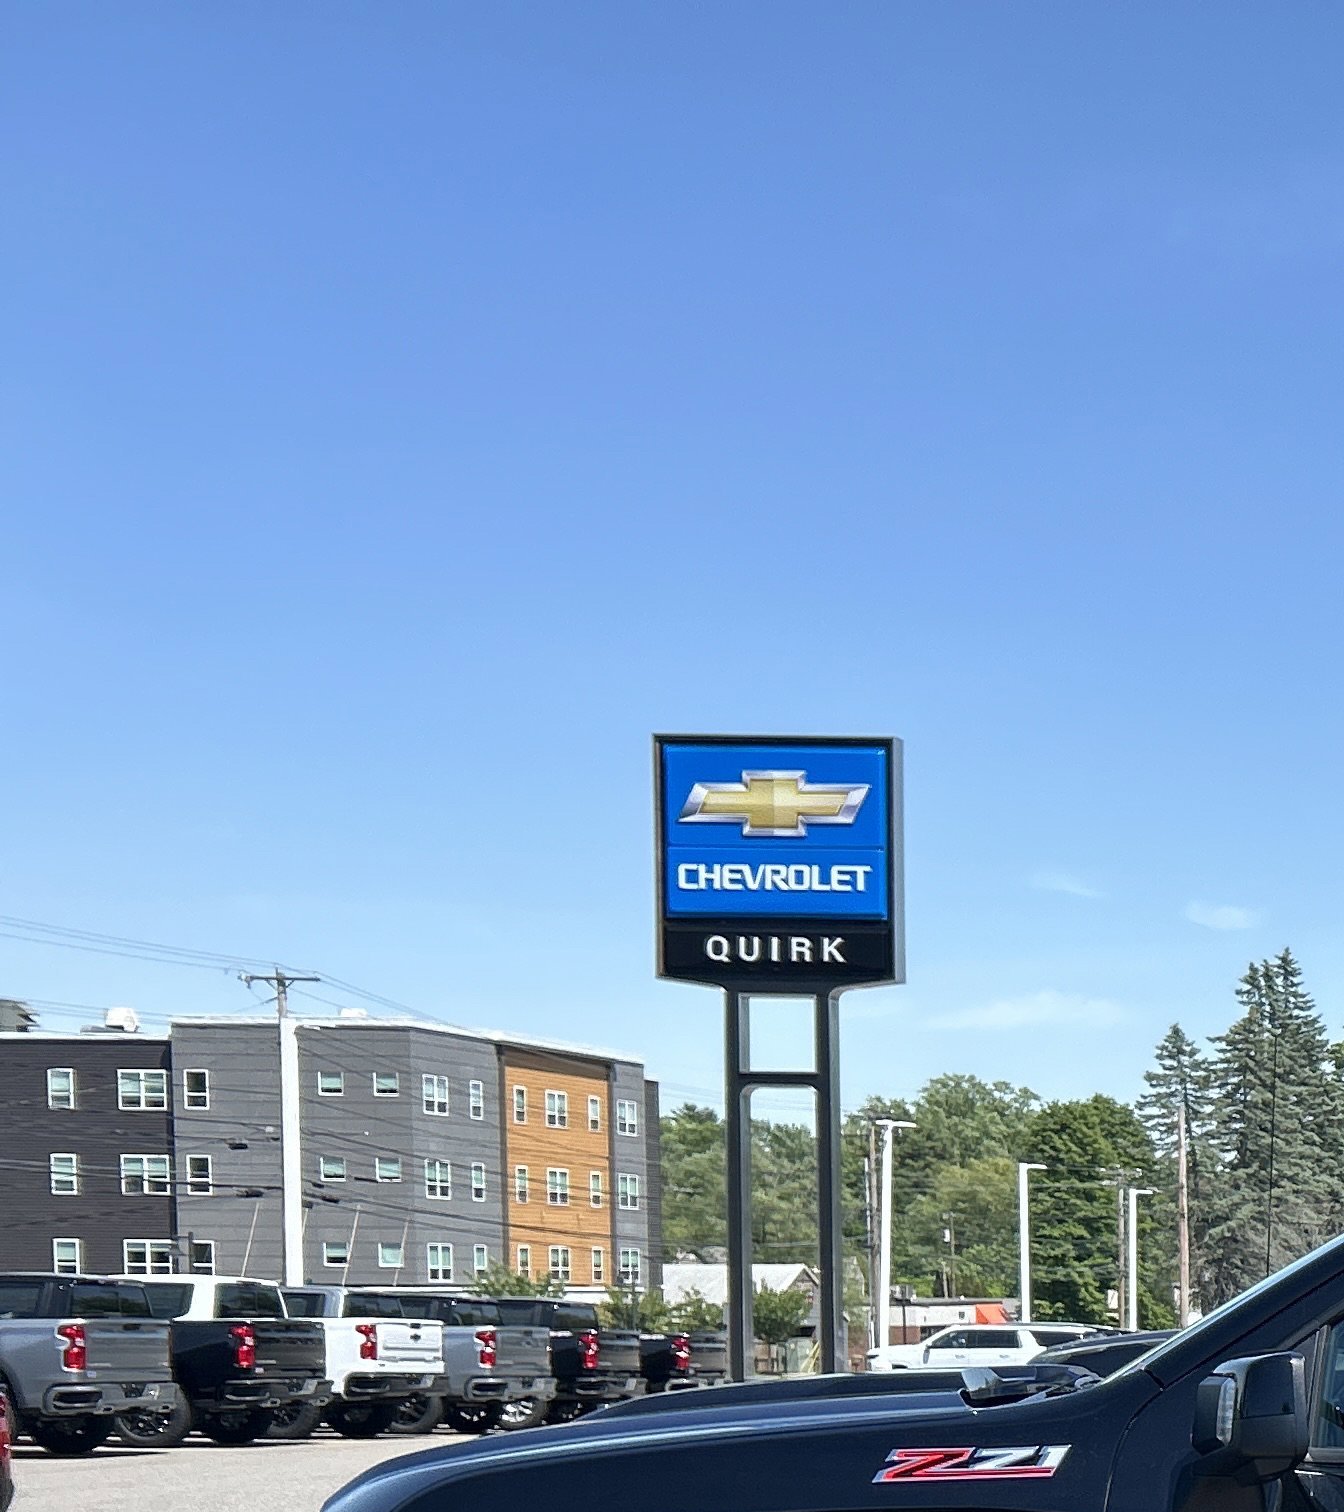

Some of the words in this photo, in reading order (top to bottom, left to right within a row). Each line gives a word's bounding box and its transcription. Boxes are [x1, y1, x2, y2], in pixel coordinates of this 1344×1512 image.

[677, 863, 873, 892] CHEVROLET
[706, 935, 848, 963] QUIRK
[871, 1444, 1073, 1484] Z71
